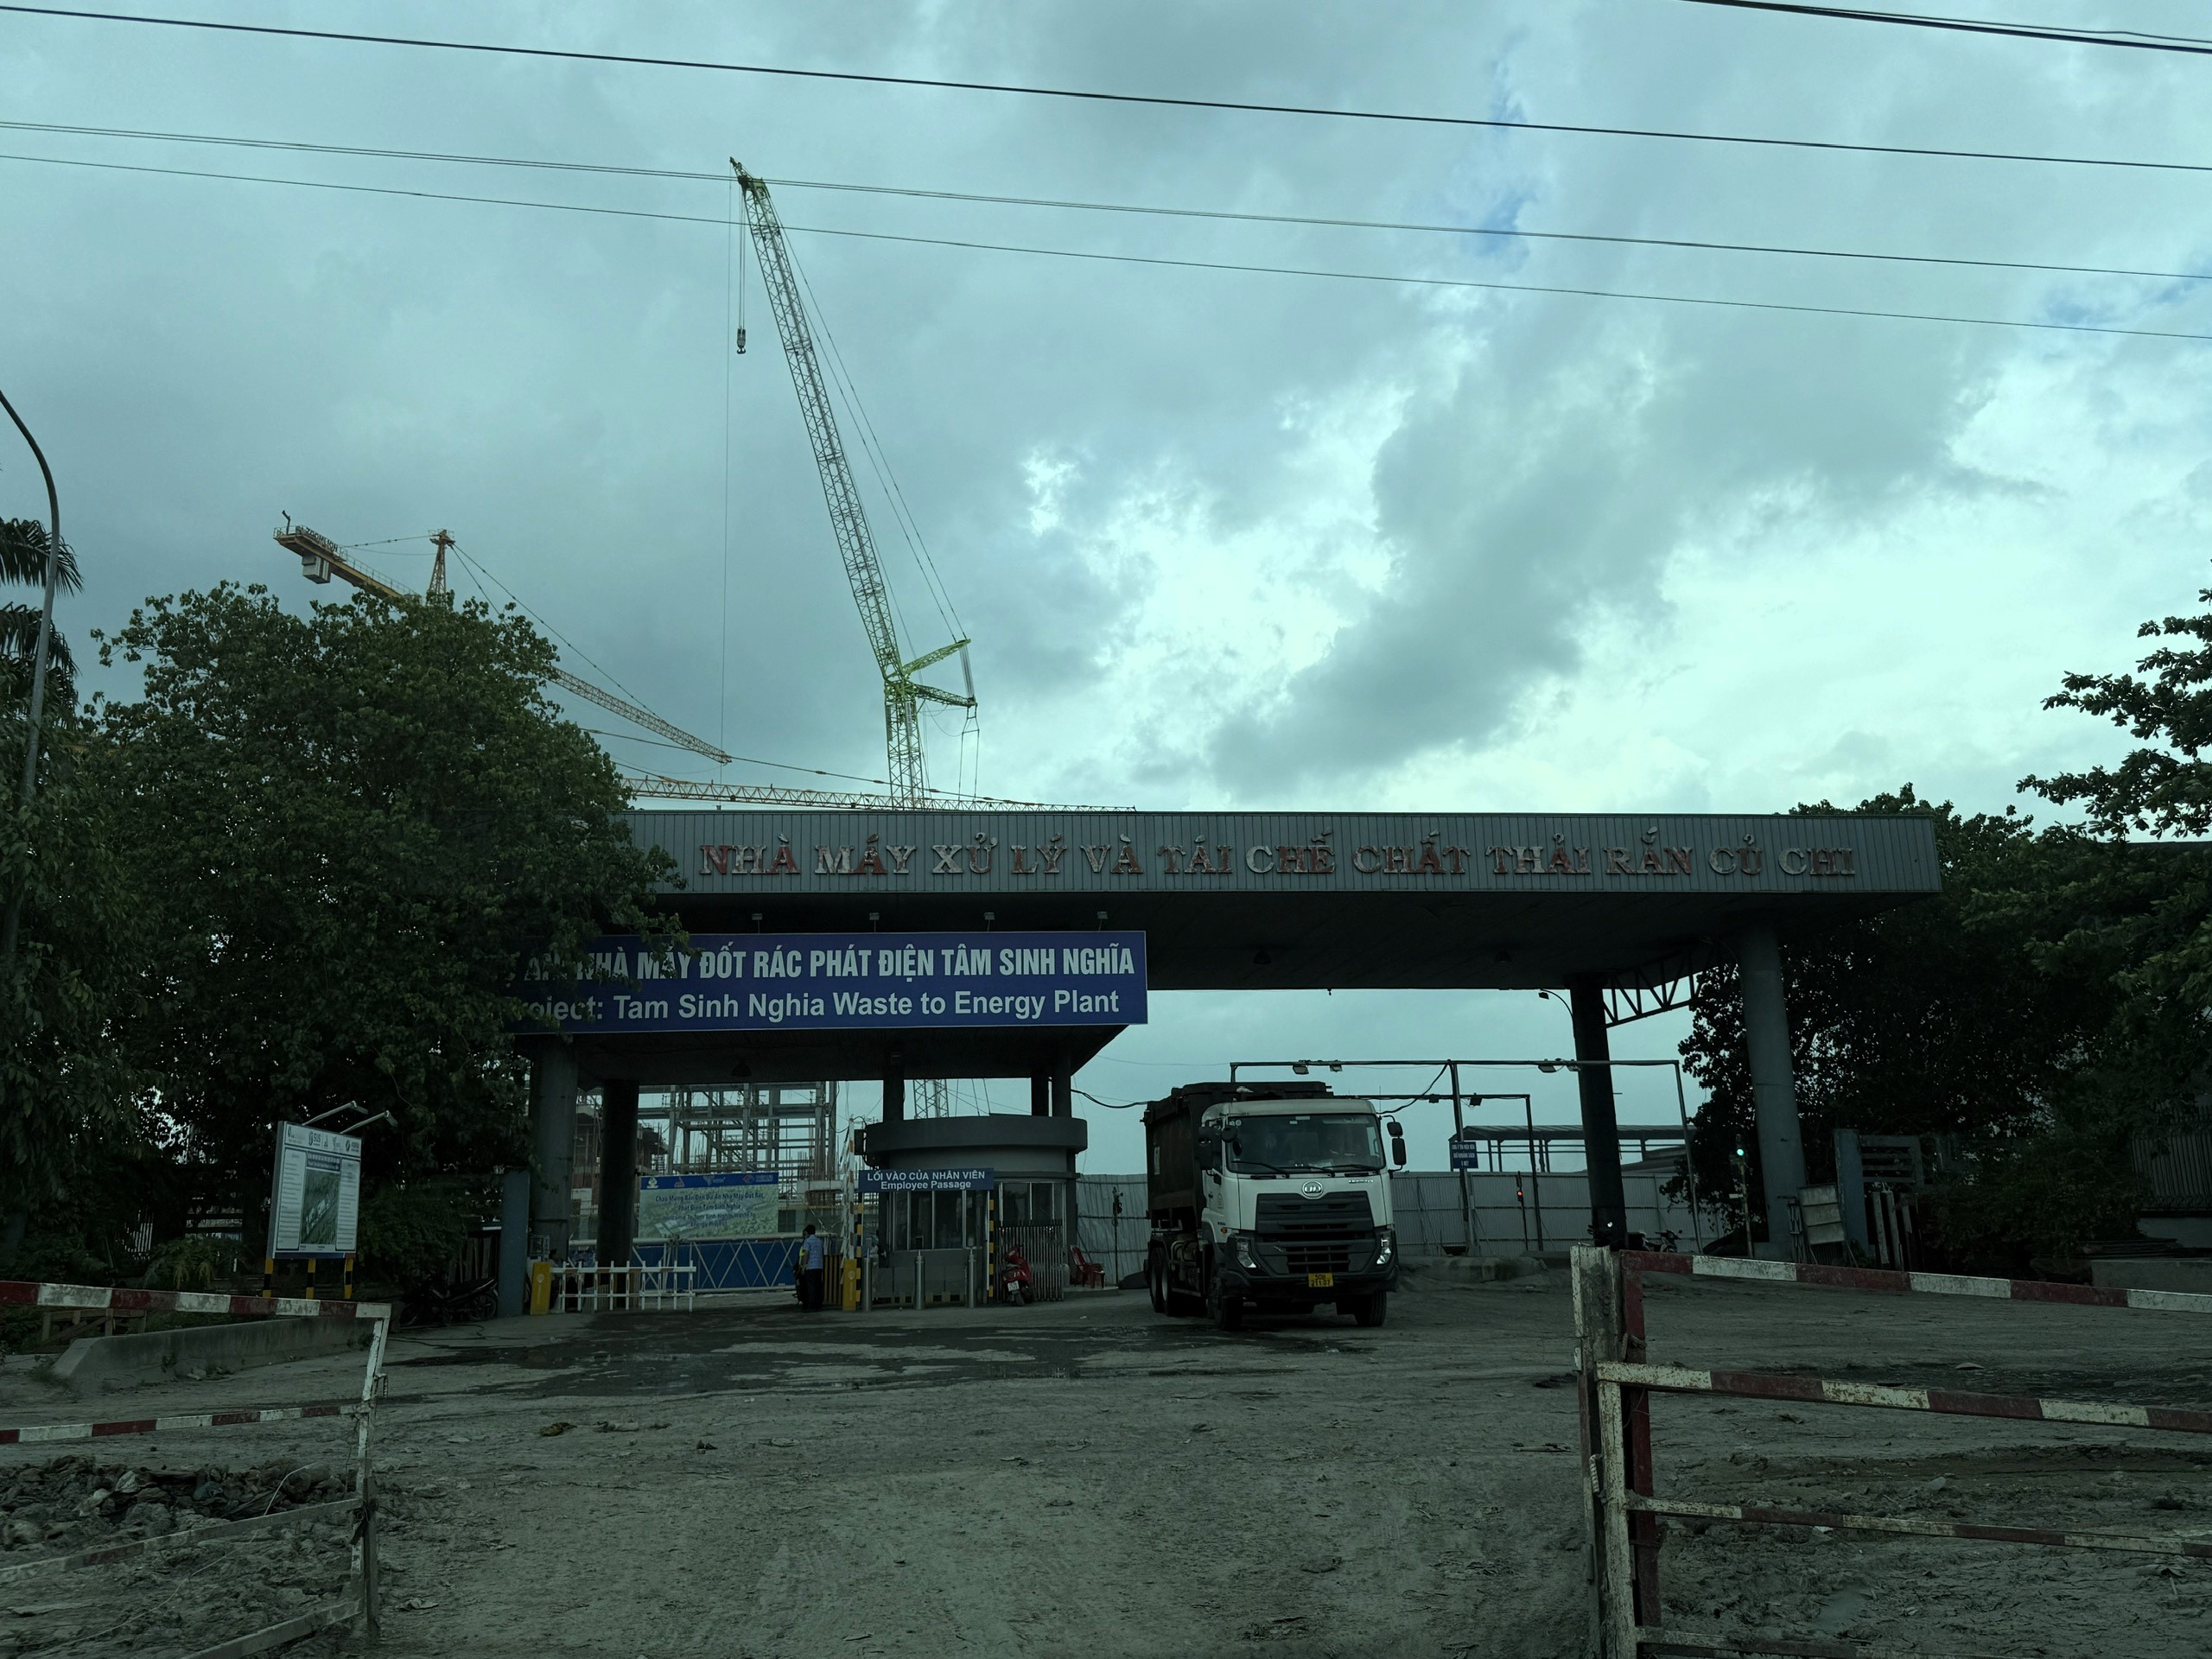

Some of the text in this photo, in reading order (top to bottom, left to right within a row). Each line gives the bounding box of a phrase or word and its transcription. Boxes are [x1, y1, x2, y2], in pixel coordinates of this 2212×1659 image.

[699, 825, 1856, 876] NHÀ MÁY XỬ LÝ VÀ TÁI CHẾ CHẤT THẢI RẮN CỦ CHI
[637, 945, 692, 980] MÁY
[699, 941, 747, 979] ĐỐT
[753, 944, 802, 978] RÁC
[810, 944, 871, 977] PHÁT
[878, 943, 934, 982] ĐIỆN
[941, 943, 992, 976] TÂM
[999, 948, 1055, 976] SINH
[1063, 942, 1135, 975] NGHĨA
[506, 989, 1120, 1023] roject: Tam Sinh Nghia Waste to Energy Plant
[880, 1179, 972, 1192] Employee Passage
[887, 1170, 906, 1181] VÀO
[908, 1169, 930, 1181] CỦA
[932, 1169, 960, 1180] NHÂN
[962, 1169, 986, 1179] VIÊN
